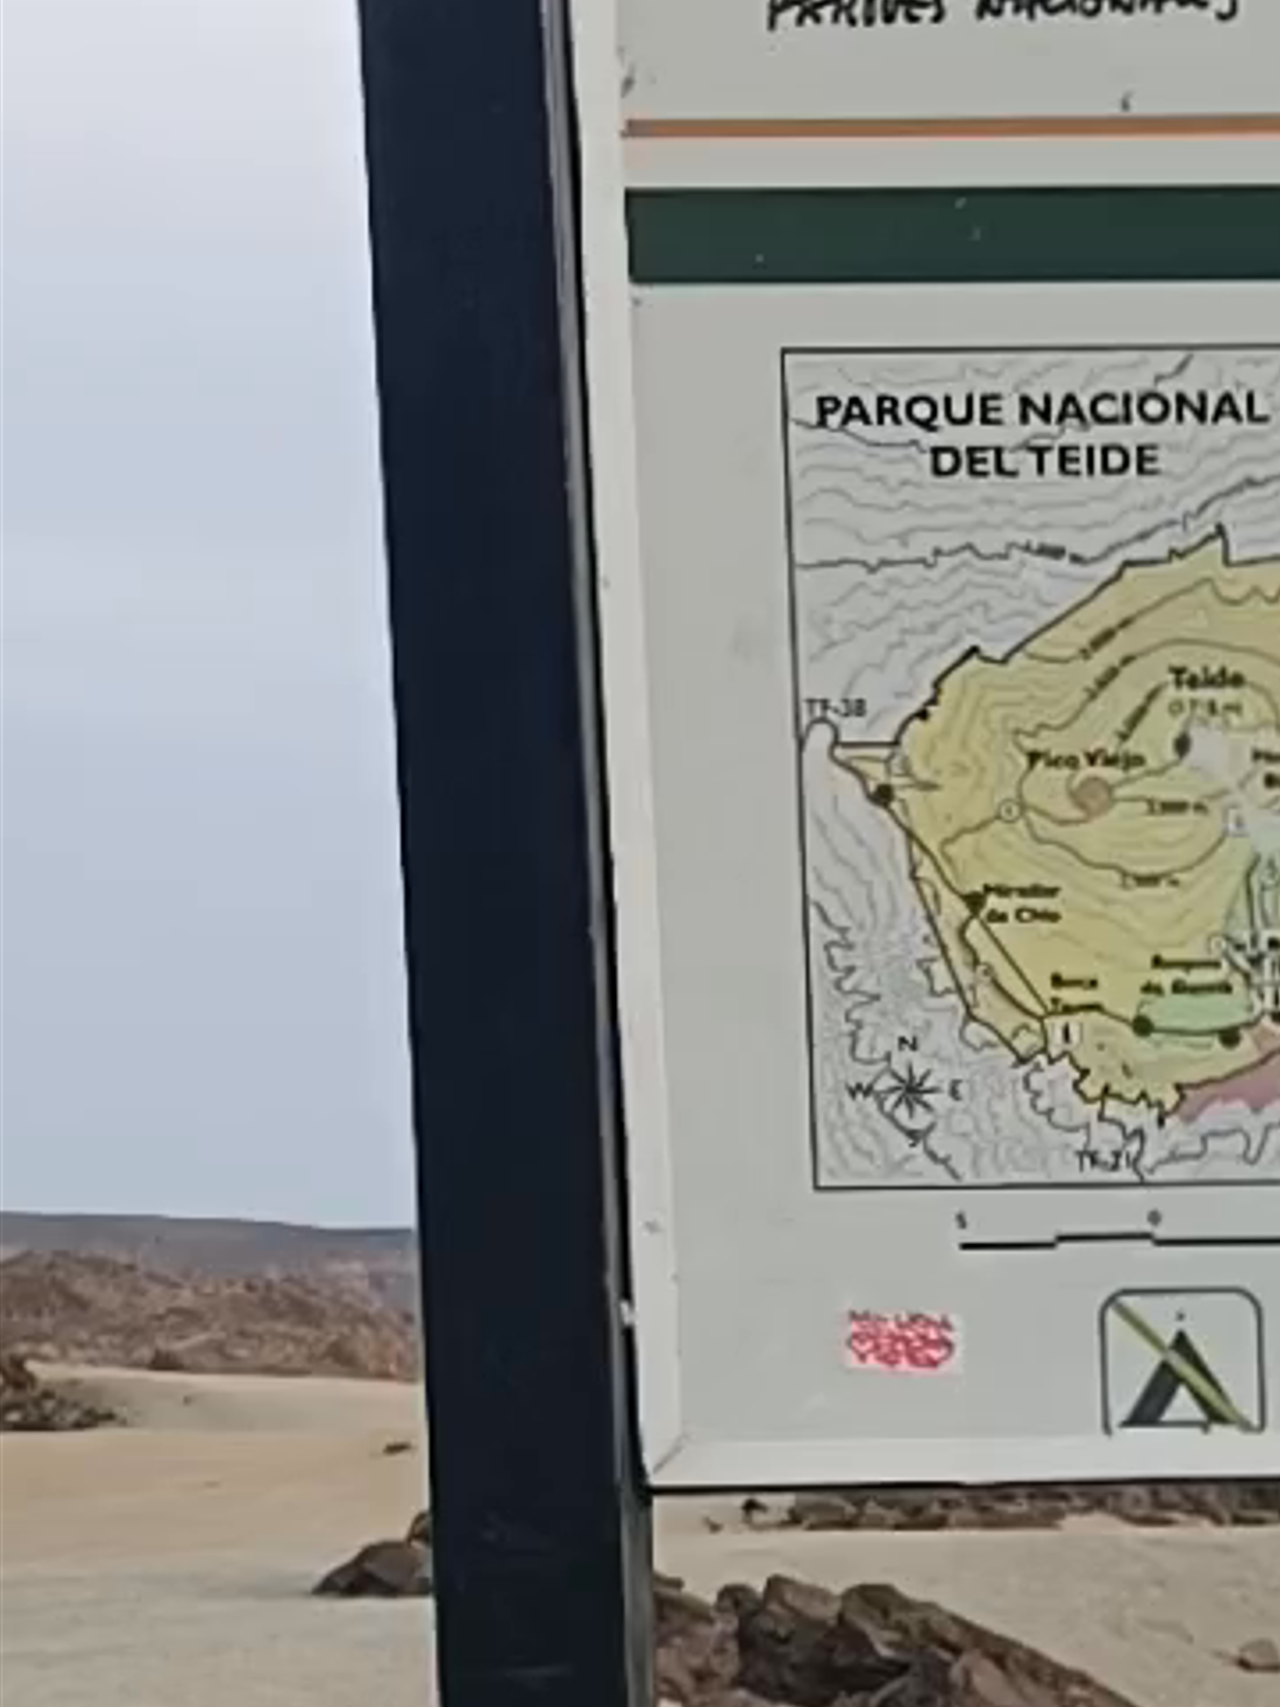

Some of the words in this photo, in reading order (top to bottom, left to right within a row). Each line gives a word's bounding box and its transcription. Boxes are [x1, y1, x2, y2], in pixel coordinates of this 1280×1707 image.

[815, 391, 1004, 431] PARQUE
[1018, 389, 1271, 427] NACIONAL
[929, 446, 1020, 478] DEL
[1032, 443, 1162, 477] TEIDE
[1168, 666, 1246, 690] Teide
[1027, 750, 1080, 770] Pico
[1084, 749, 1146, 772] Viejo
[897, 1036, 919, 1051] N
